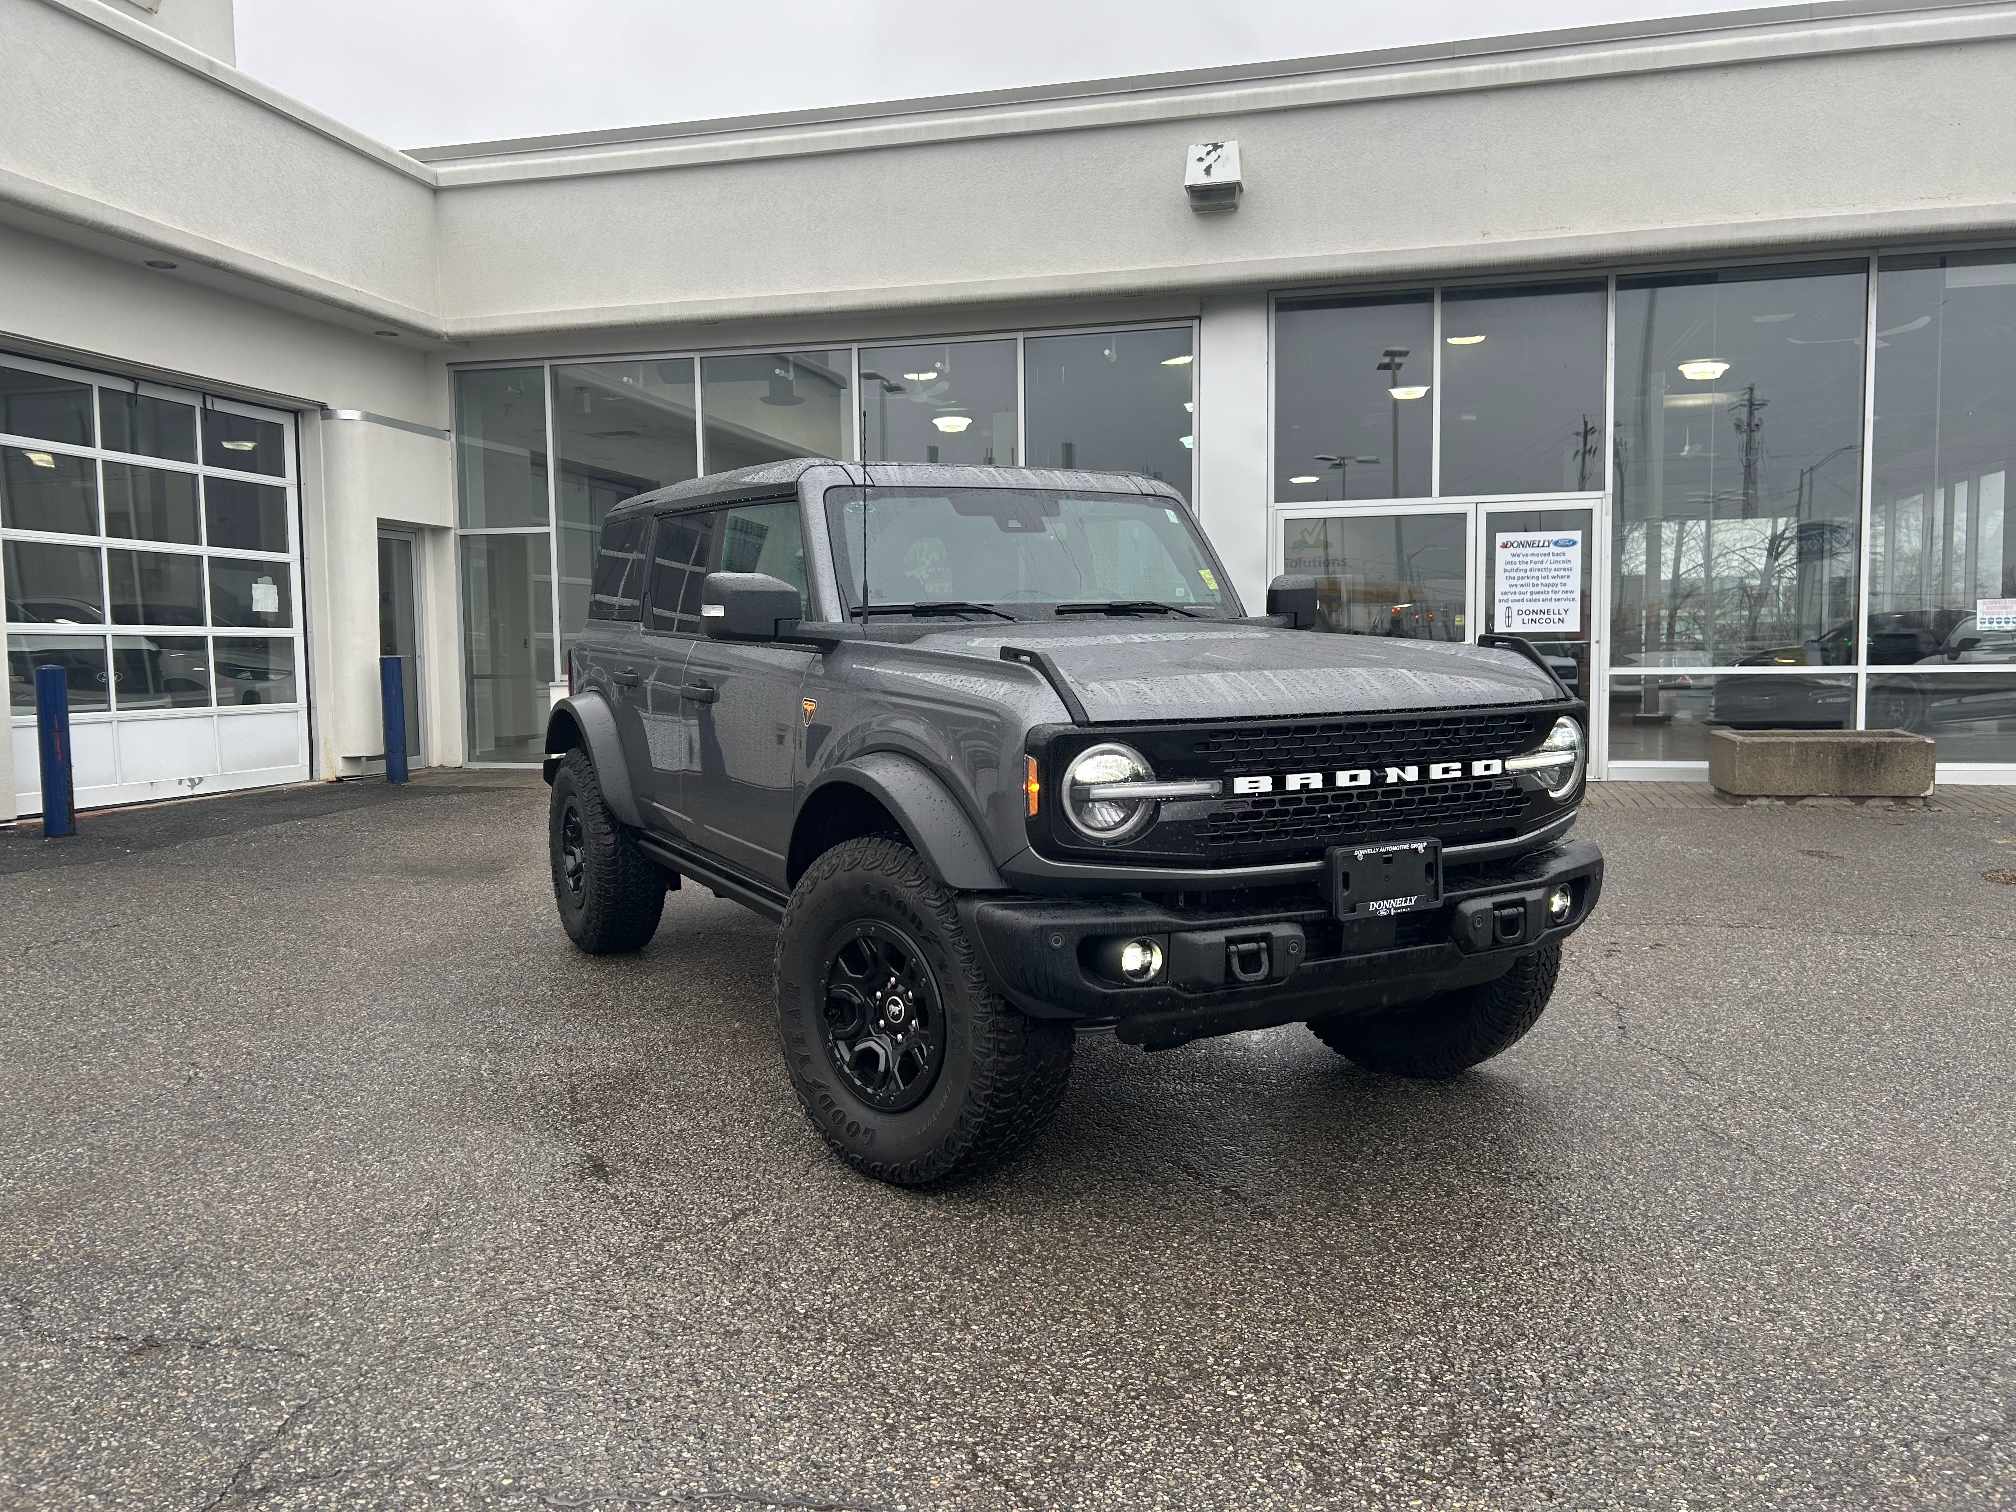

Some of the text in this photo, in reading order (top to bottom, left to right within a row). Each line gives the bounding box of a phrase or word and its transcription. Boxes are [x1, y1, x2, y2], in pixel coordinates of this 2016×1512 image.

[1505, 539, 1553, 548] DONNELLY
[1516, 608, 1569, 616] DONNELLY
[1521, 617, 1565, 625] LINCOLN
[1233, 759, 1502, 794] BRONCO
[1353, 847, 1380, 856] DONNELLY
[1379, 843, 1410, 853] AUTOMOTIVE
[1368, 895, 1418, 911] DONNELLY
